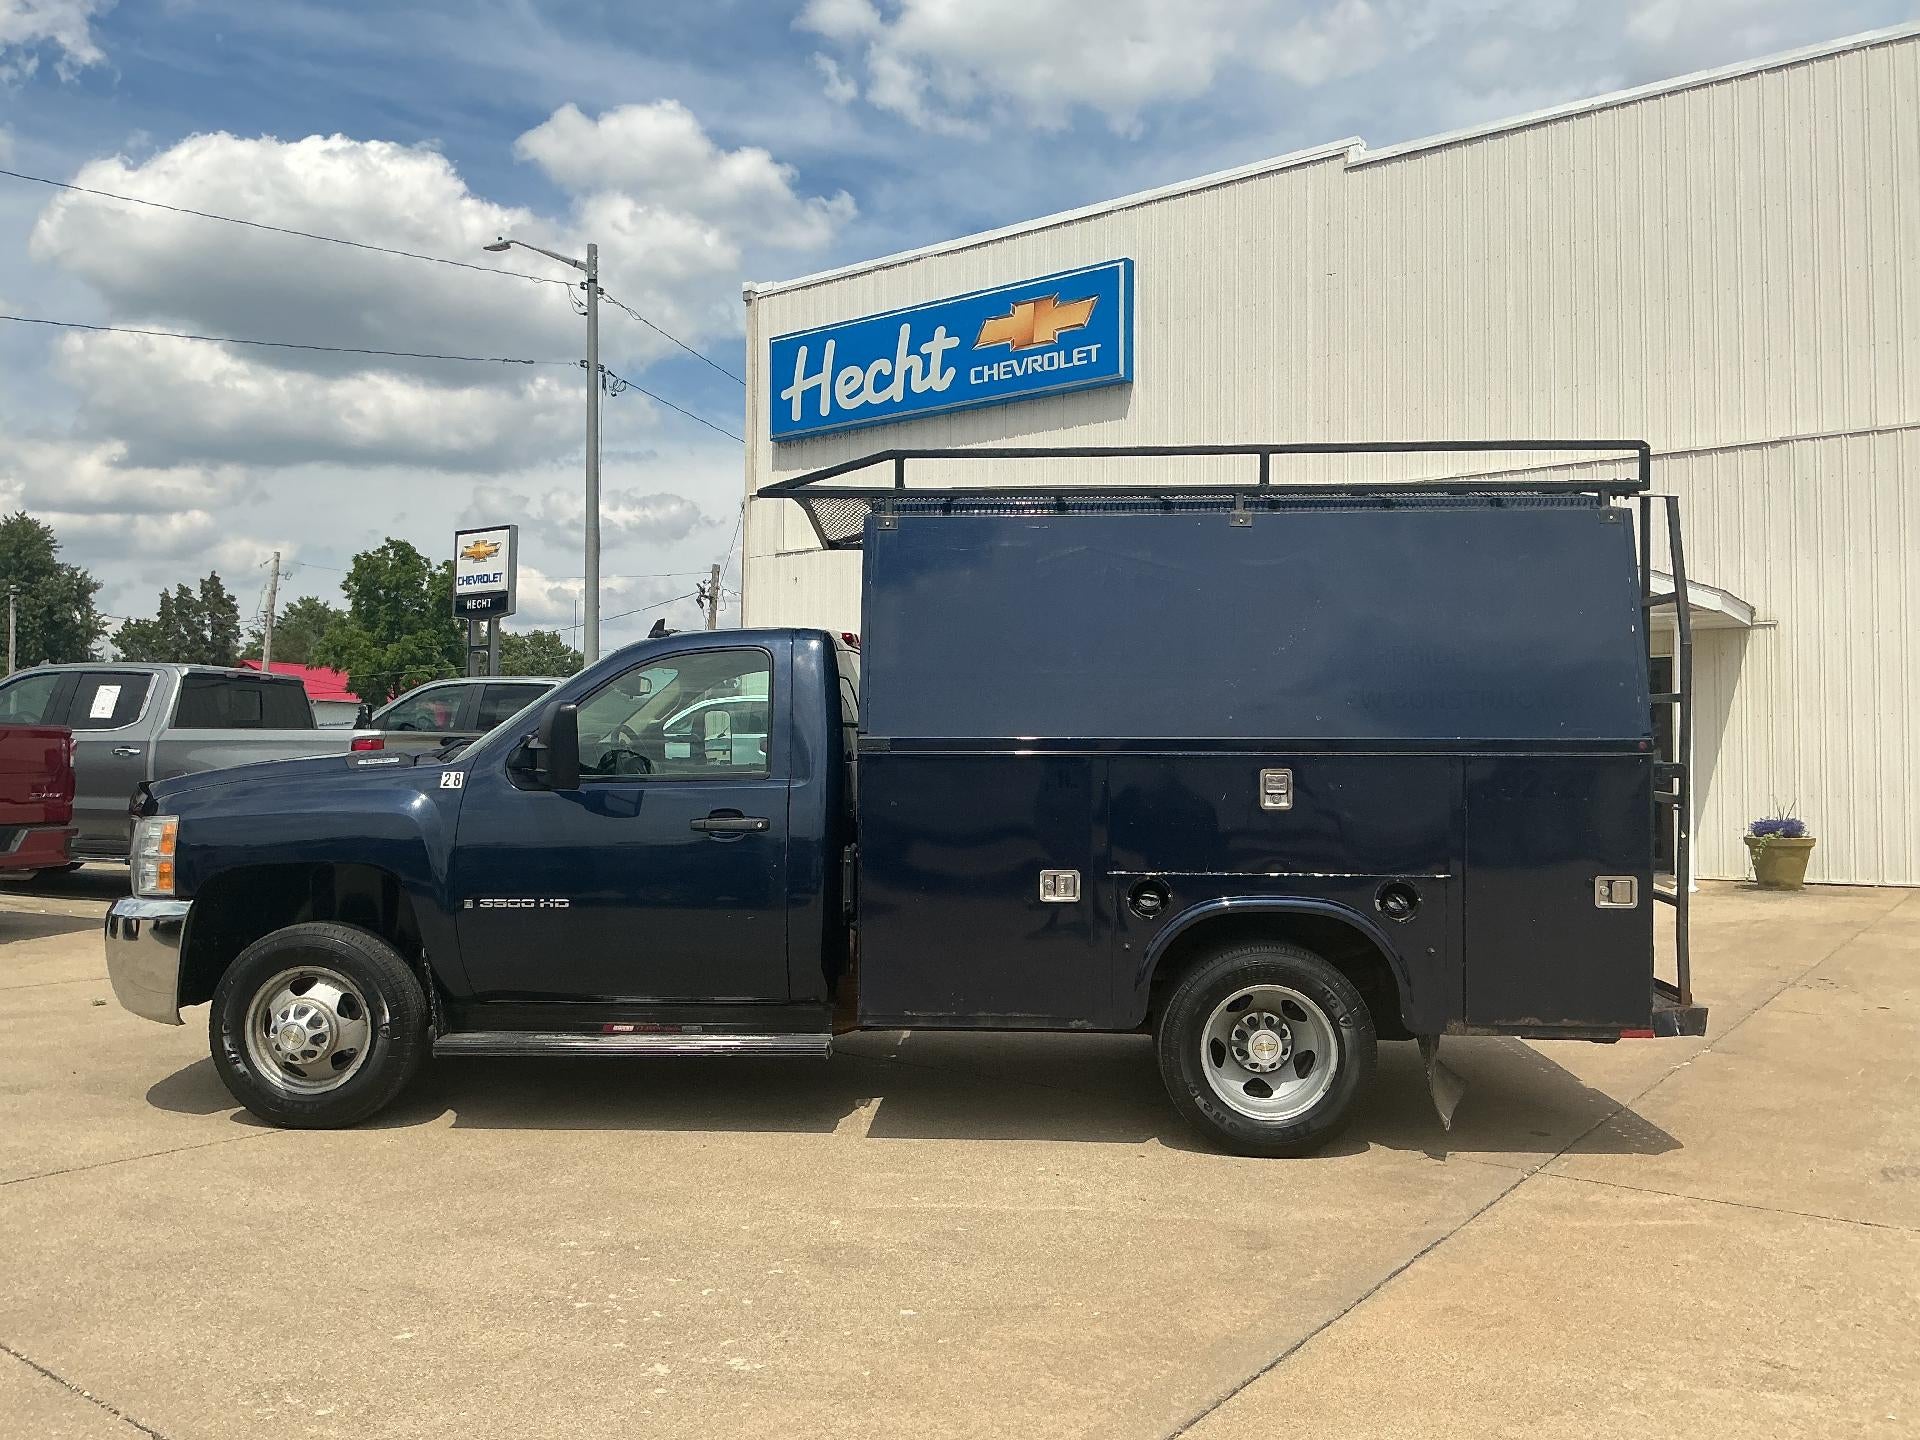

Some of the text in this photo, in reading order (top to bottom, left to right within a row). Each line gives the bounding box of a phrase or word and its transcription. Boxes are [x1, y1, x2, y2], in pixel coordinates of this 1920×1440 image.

[969, 343, 1102, 386] CHEVROLET
[781, 323, 960, 422] Hecht
[457, 572, 503, 587] CHEVROLET
[466, 598, 492, 610] HECHT
[442, 772, 462, 787] 28
[479, 898, 570, 908] 3500 HD
